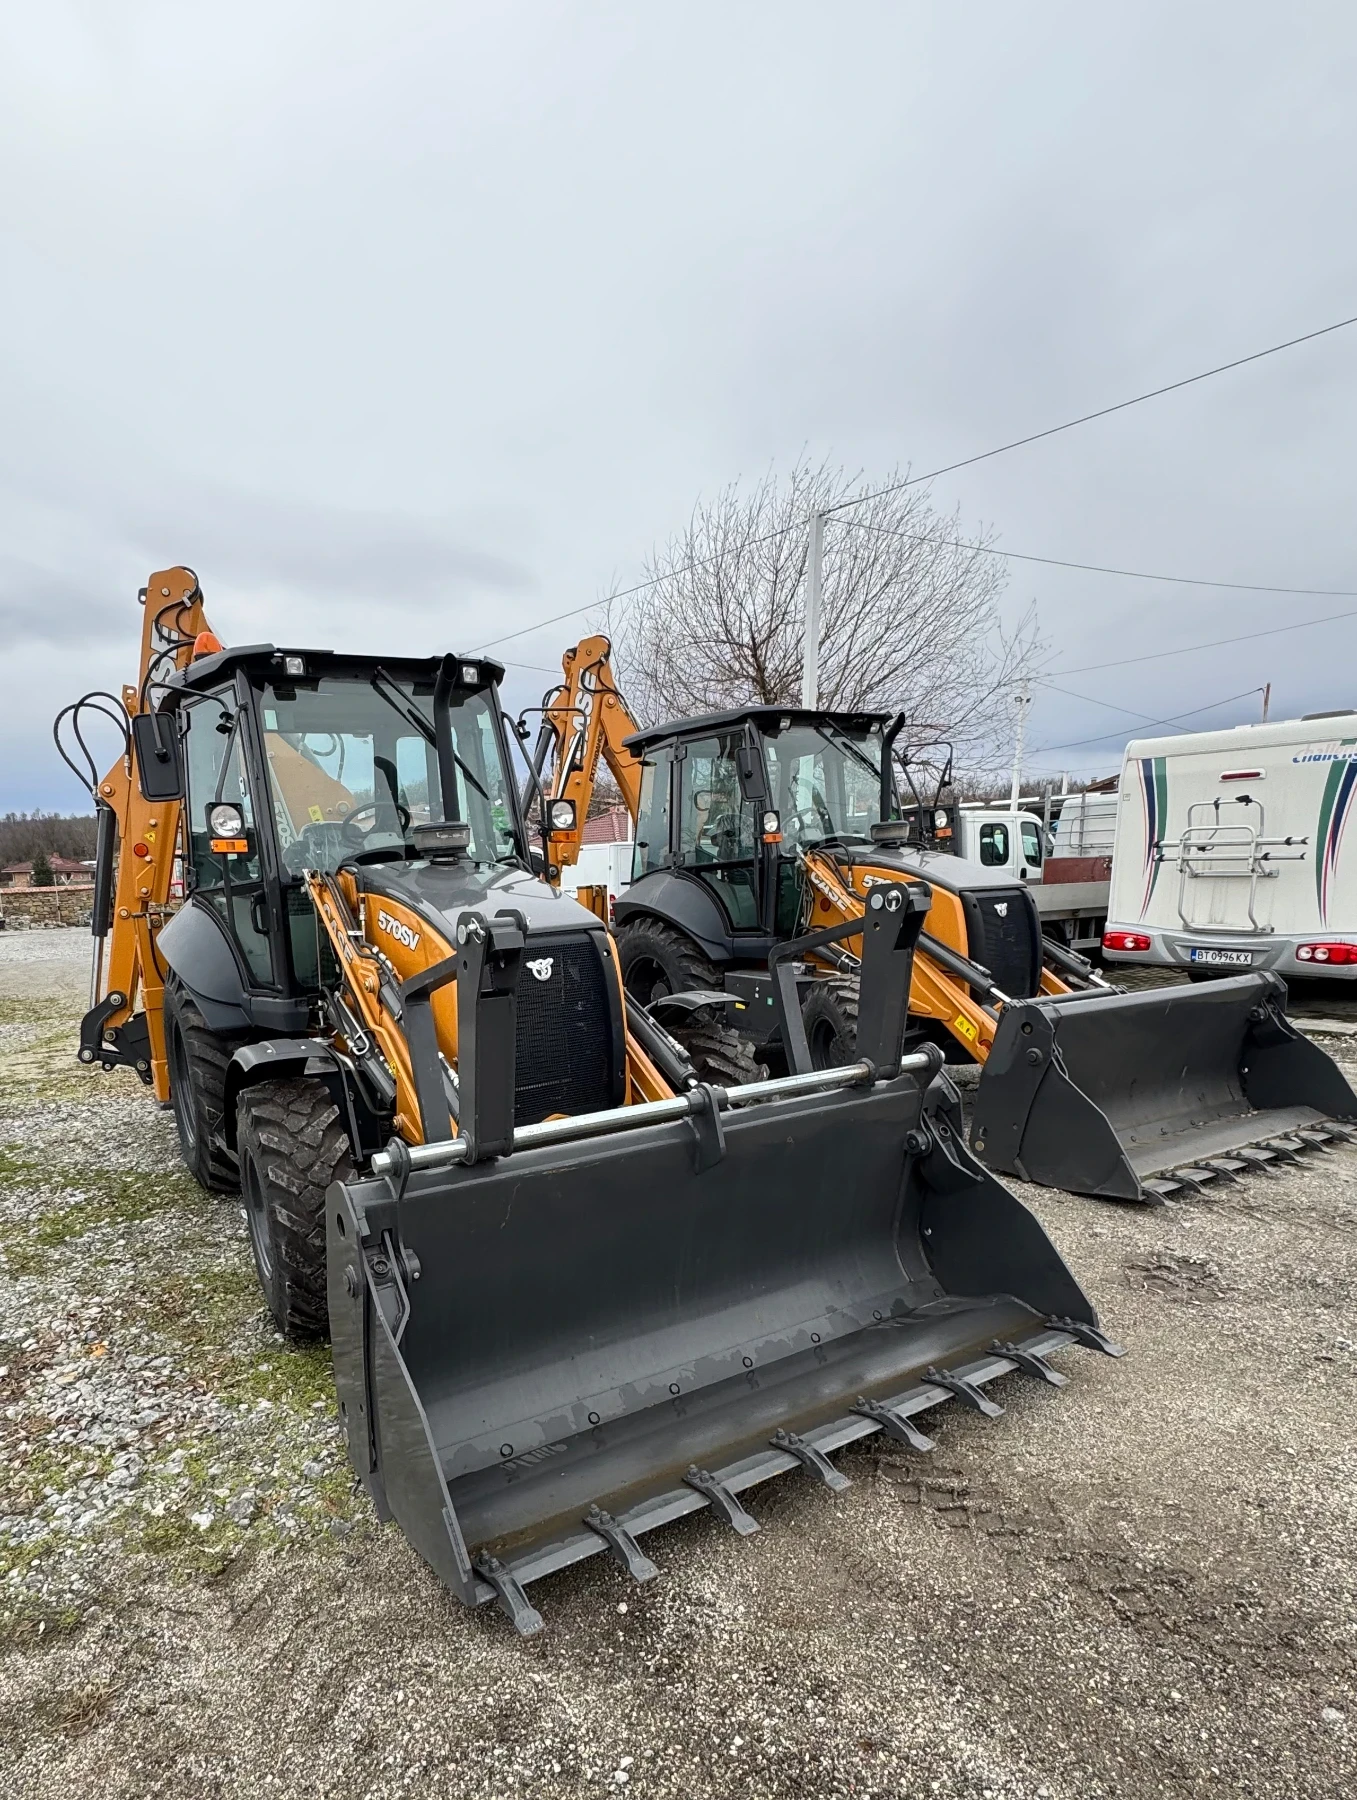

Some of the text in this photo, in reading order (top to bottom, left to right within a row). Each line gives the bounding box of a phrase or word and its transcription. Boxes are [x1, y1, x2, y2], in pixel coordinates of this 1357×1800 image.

[811, 870, 848, 911] CASE
[378, 908, 421, 952] 570SV
[1197, 950, 1250, 963] BT 0996 KX
